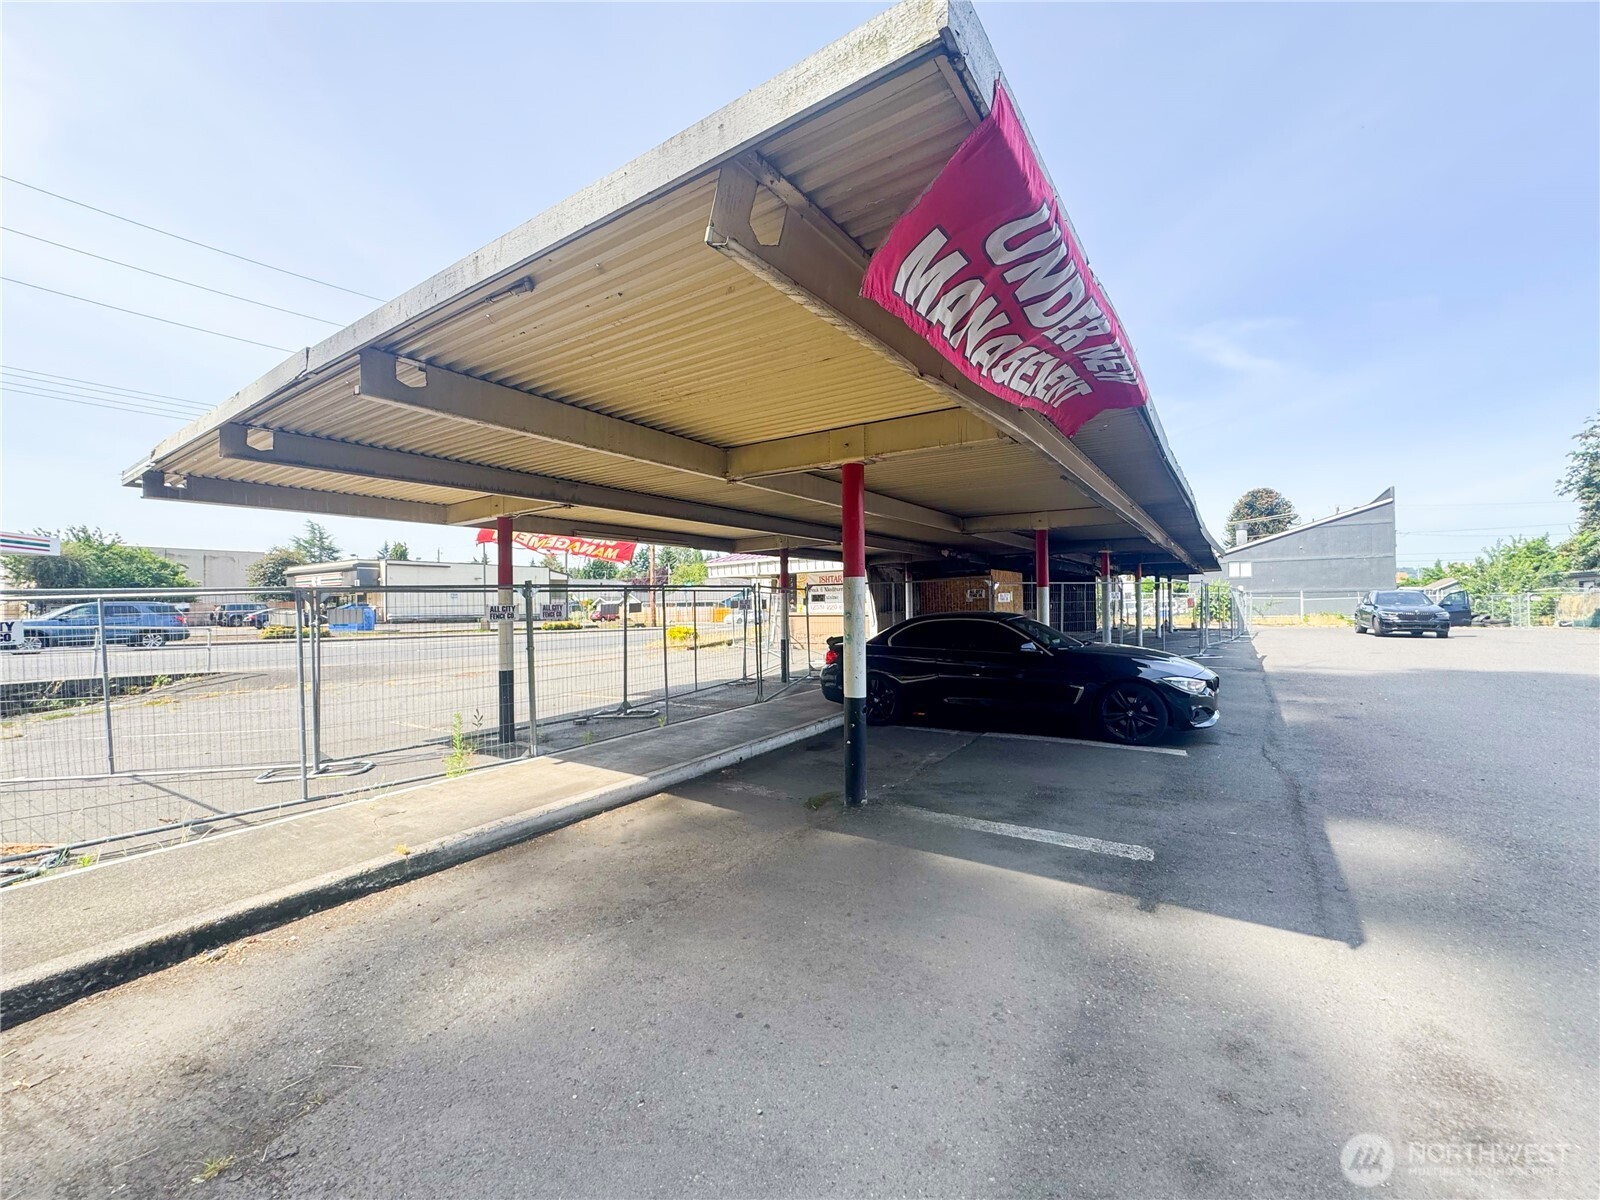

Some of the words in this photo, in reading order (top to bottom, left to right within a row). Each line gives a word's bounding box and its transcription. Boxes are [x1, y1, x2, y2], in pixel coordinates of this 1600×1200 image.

[893, 226, 1095, 409] MANAGEMENT
[984, 201, 1111, 352] UNDER
[490, 605, 502, 613] ALL
